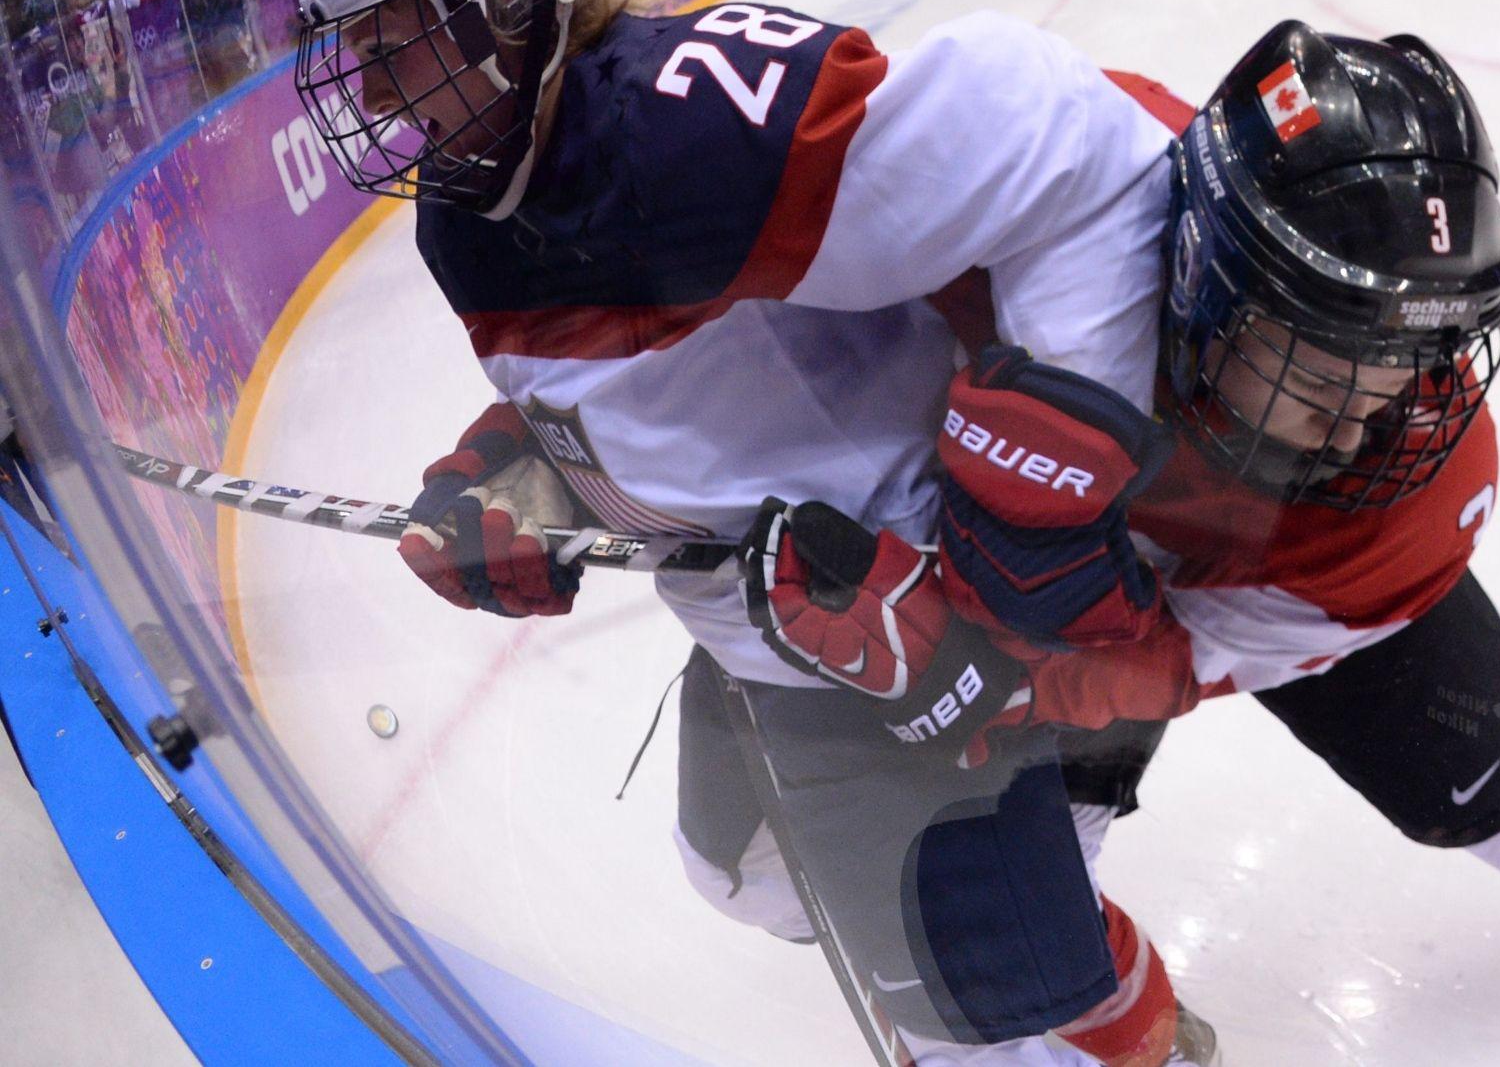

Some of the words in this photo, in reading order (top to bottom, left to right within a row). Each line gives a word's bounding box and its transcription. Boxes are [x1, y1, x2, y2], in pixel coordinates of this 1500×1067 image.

[655, 3, 825, 127] 28
[1425, 197, 1451, 254] 3
[1400, 297, 1468, 315] sochi.ru
[532, 418, 593, 466] USA
[943, 408, 1095, 498] BAUER
